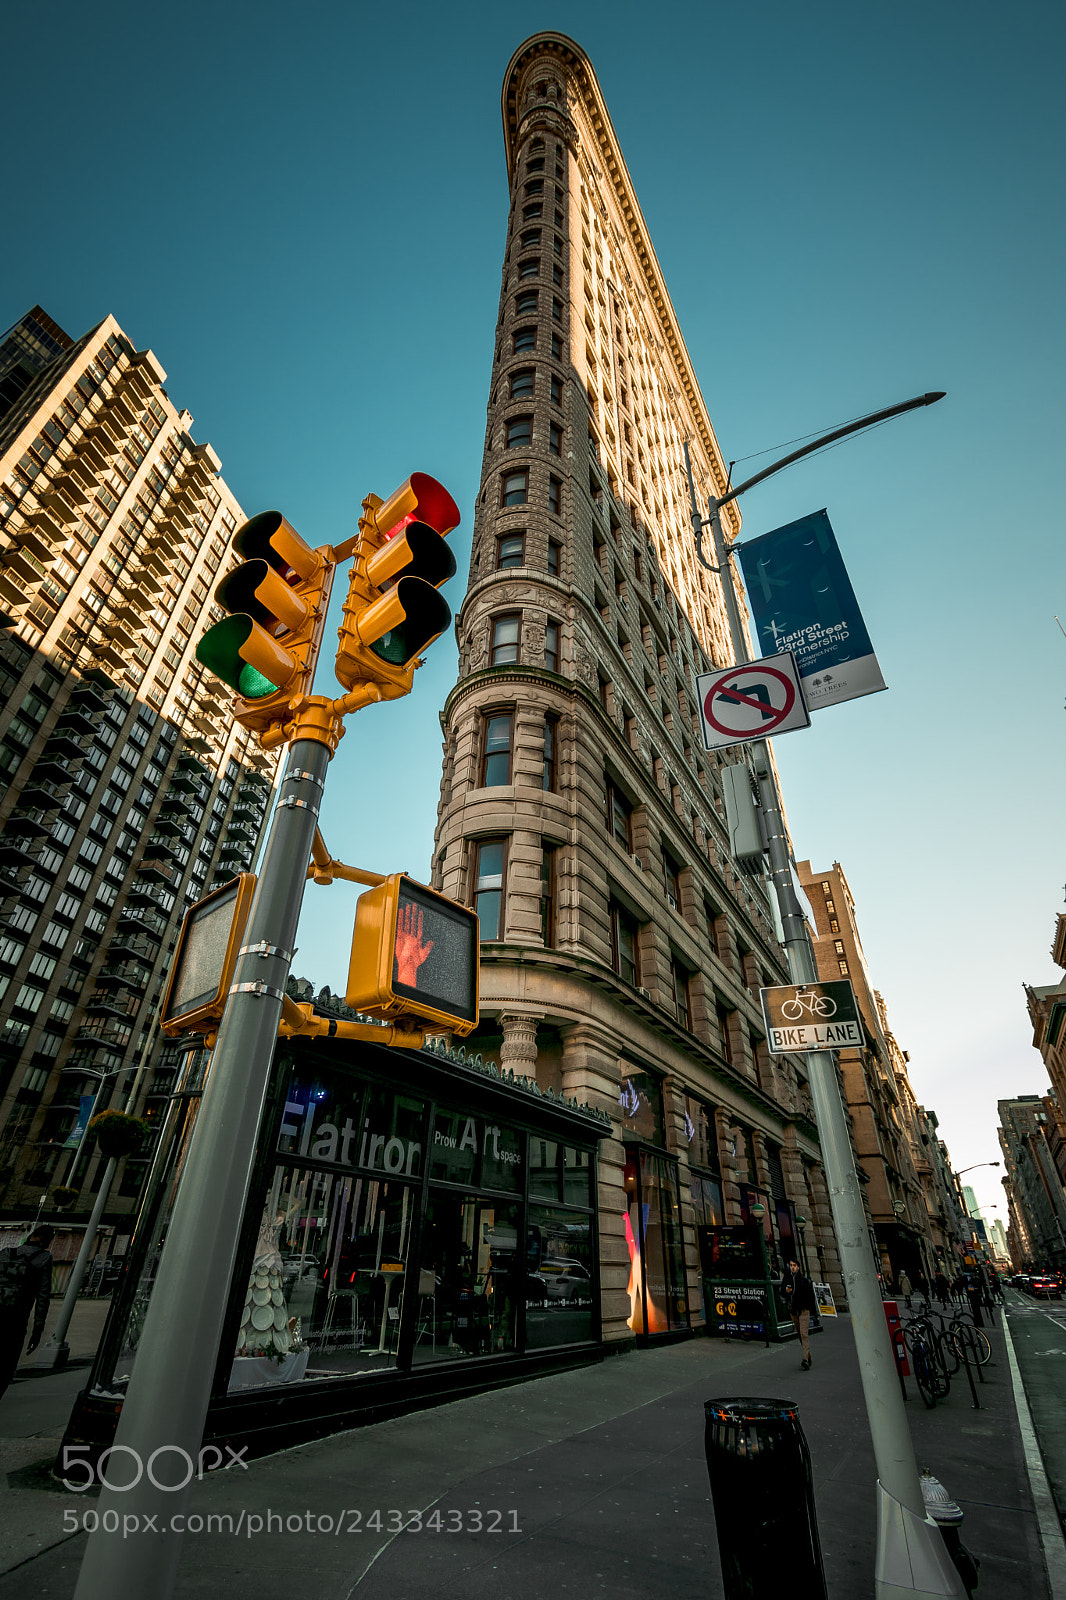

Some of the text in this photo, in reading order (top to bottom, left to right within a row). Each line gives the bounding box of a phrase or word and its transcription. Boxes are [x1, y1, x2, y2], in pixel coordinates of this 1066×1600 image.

[775, 622, 821, 648] Flatiron
[777, 620, 848, 654] 23rd Street
[794, 631, 850, 656] rtnership
[773, 1024, 858, 1046] BIKE LANE
[434, 1117, 521, 1165] Prow Art space
[723, 1287, 742, 1295] Street
[743, 1287, 765, 1296] Station
